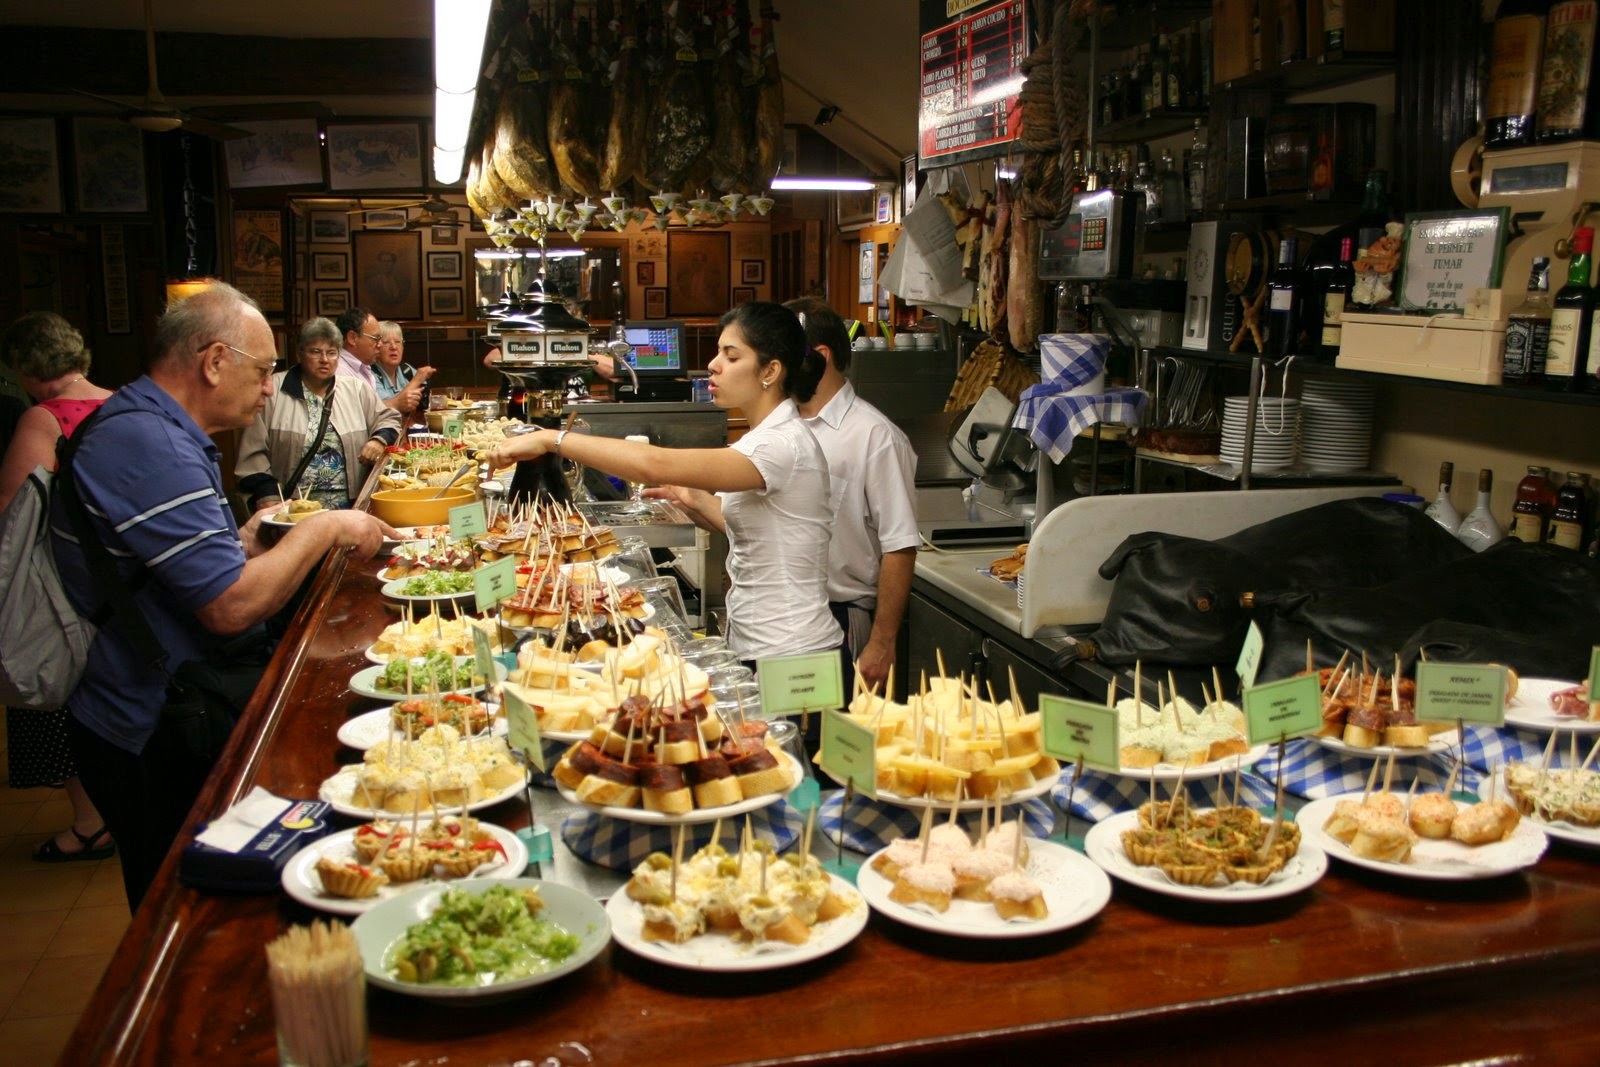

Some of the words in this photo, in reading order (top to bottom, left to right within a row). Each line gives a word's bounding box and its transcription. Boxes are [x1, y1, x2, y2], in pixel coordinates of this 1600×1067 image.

[971, 54, 986, 69] QUESO
[1425, 243, 1435, 254] SE
[1433, 259, 1463, 270] FUMAR
[511, 344, 537, 352] Mahou
[554, 344, 580, 352] Mahou
